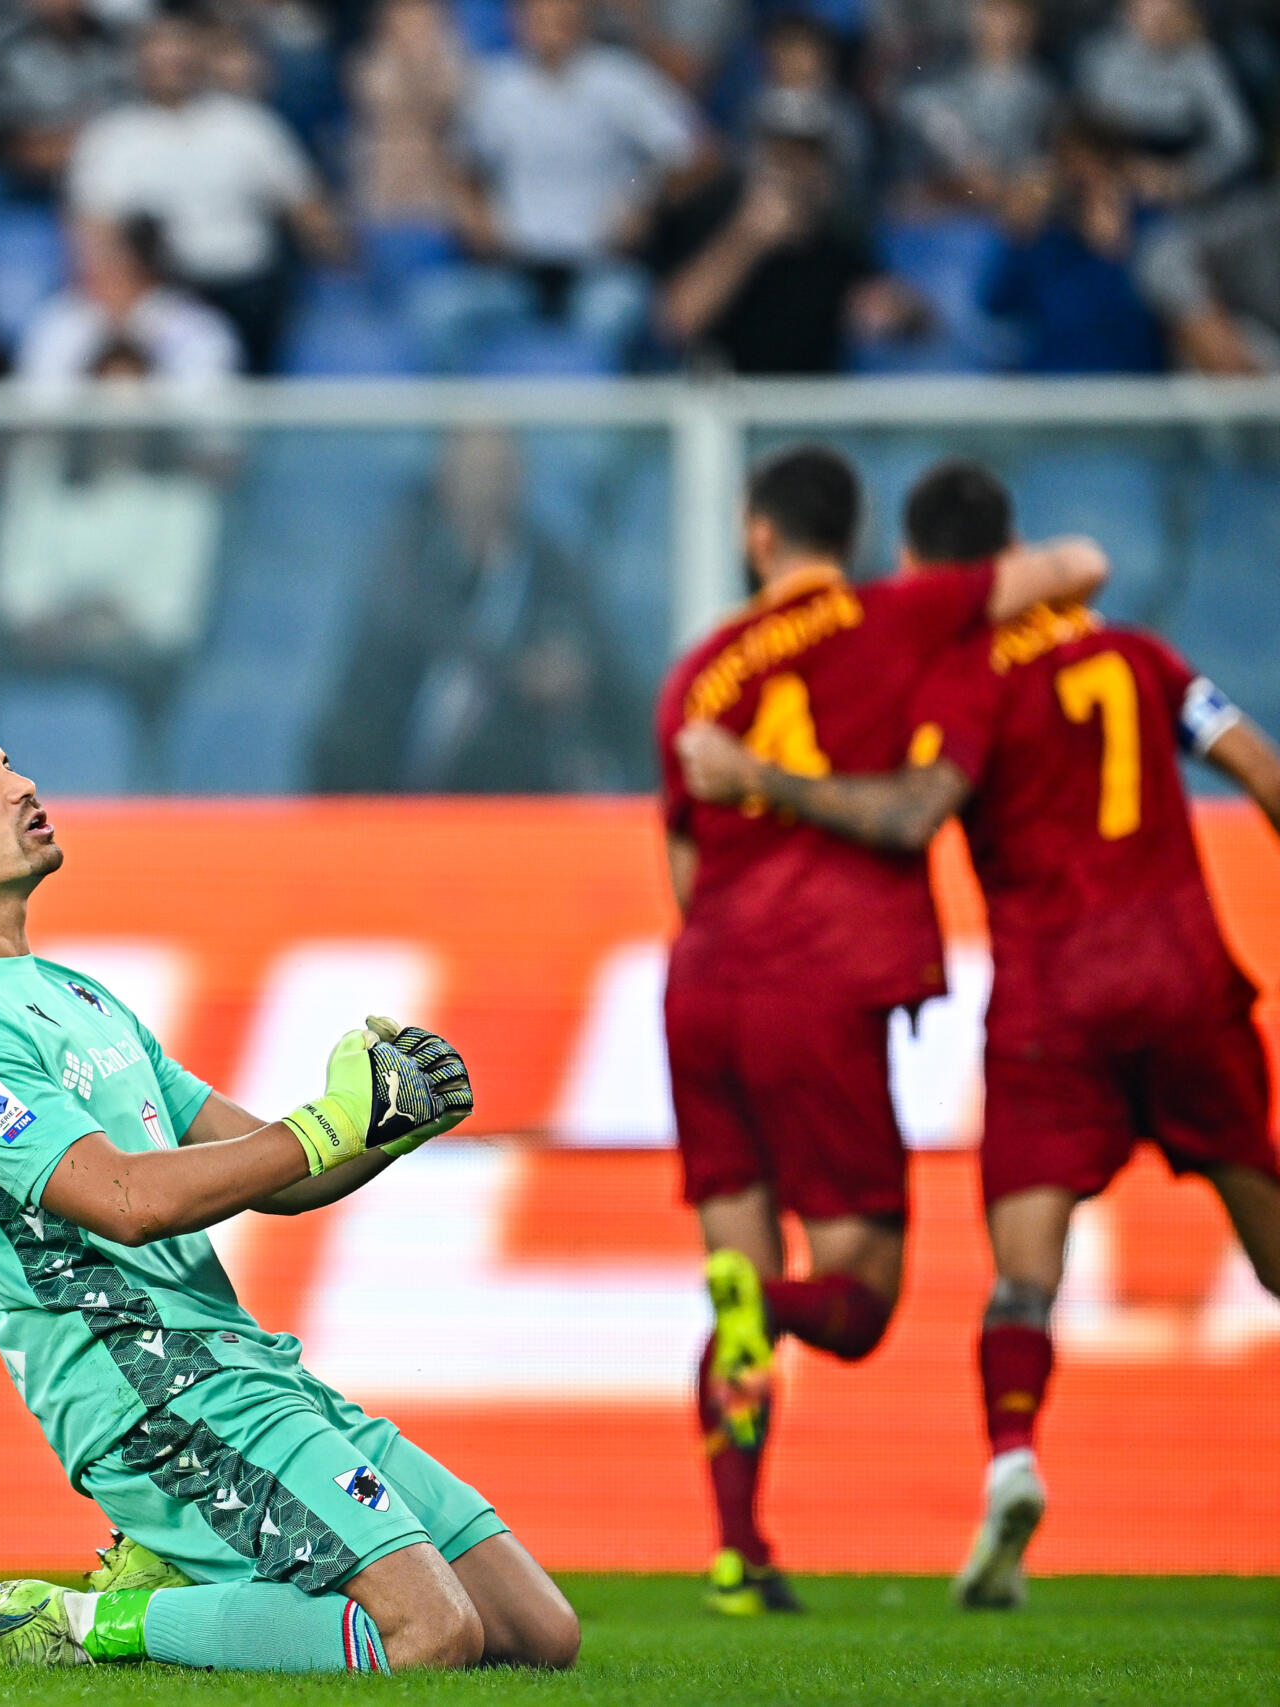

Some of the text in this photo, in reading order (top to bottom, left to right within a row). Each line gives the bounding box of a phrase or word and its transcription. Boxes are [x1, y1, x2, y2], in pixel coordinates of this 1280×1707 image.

[1055, 650, 1141, 841] 7
[14, 1114, 33, 1131] TIM
[314, 1114, 340, 1147] AUDERO
